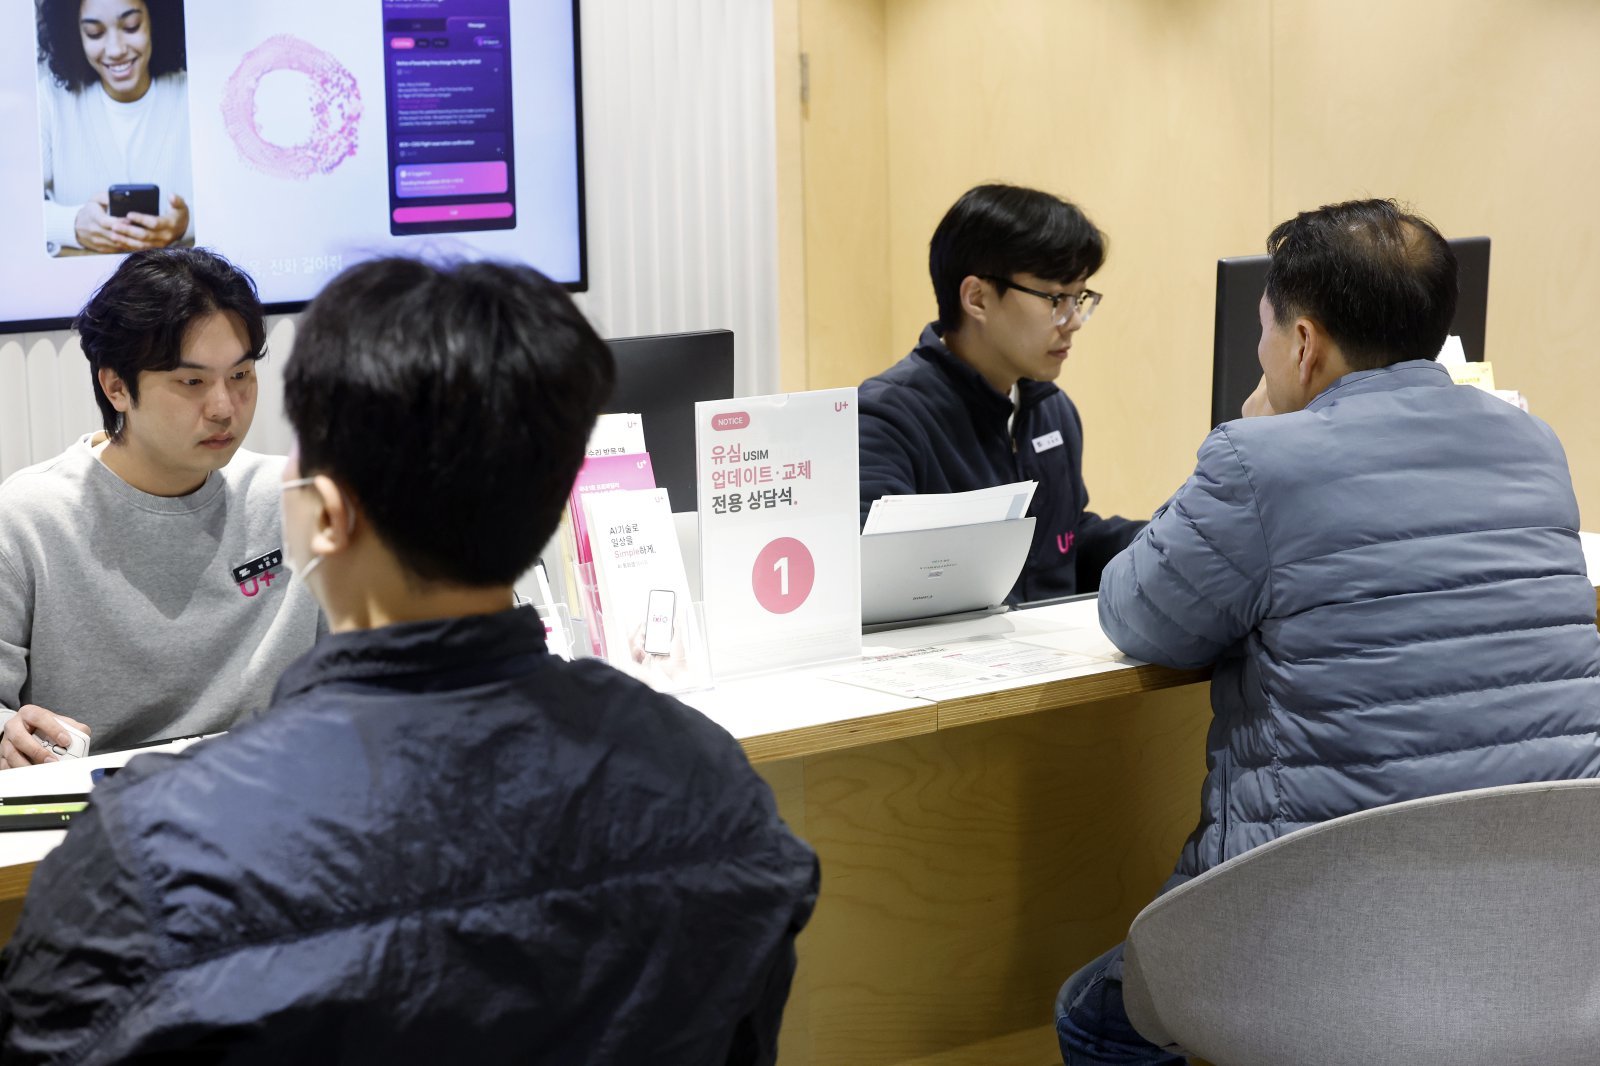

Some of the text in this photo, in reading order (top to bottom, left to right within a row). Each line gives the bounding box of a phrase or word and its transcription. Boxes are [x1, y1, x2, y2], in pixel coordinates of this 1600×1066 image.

[834, 401, 849, 413] U+
[718, 416, 744, 426] NOTICE
[711, 443, 769, 465] 유심 USIM
[711, 493, 743, 515] 전용
[611, 535, 633, 548] 일상을
[1057, 531, 1075, 554] U+
[240, 570, 275, 597] U+
[773, 556, 790, 597] 1
